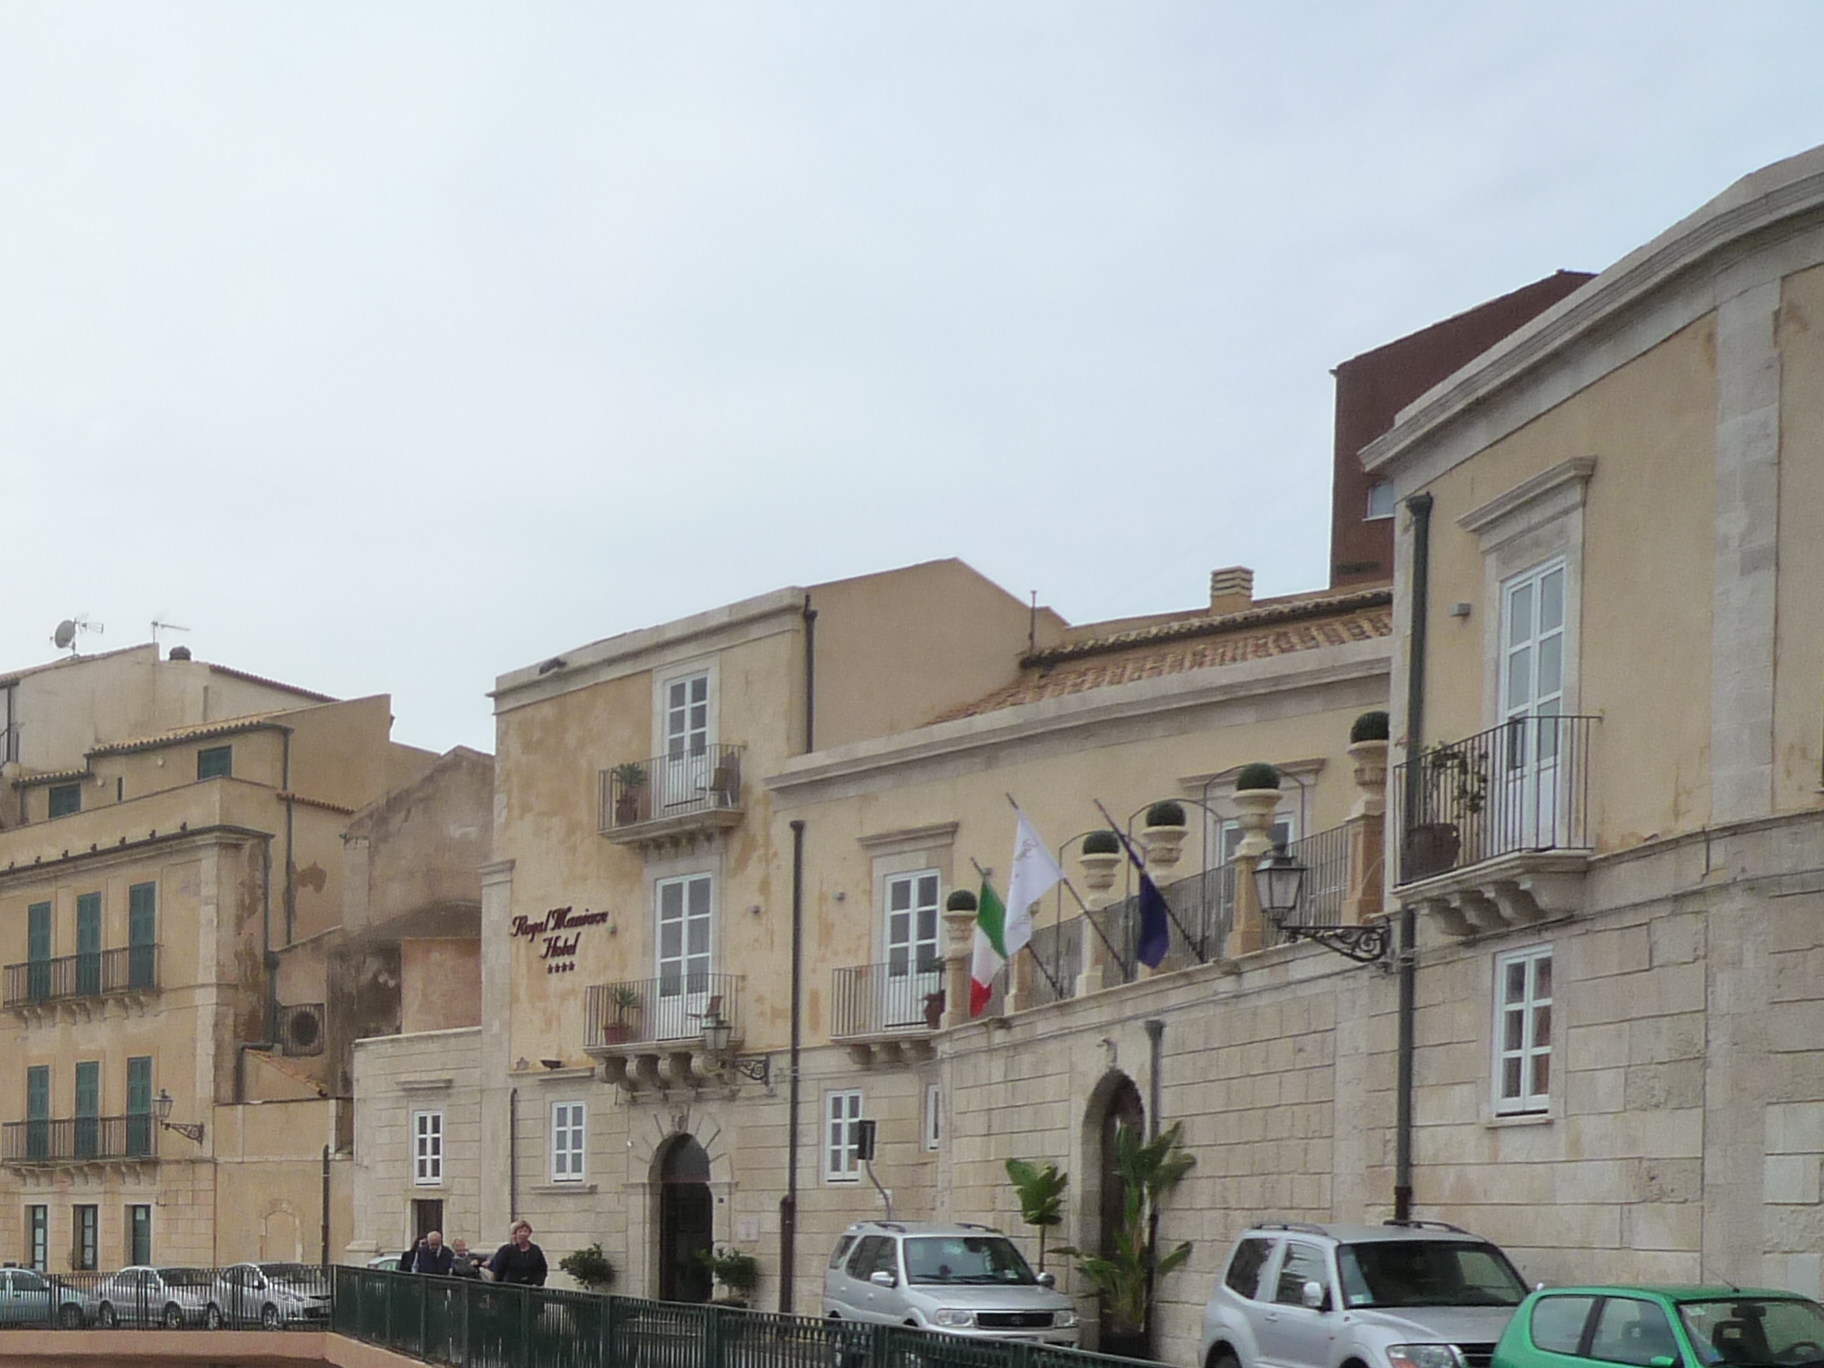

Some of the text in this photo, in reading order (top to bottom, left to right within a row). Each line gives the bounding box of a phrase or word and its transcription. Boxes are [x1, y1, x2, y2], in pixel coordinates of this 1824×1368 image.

[510, 906, 608, 943] Royal Maniace
[539, 931, 581, 959] Hotel
